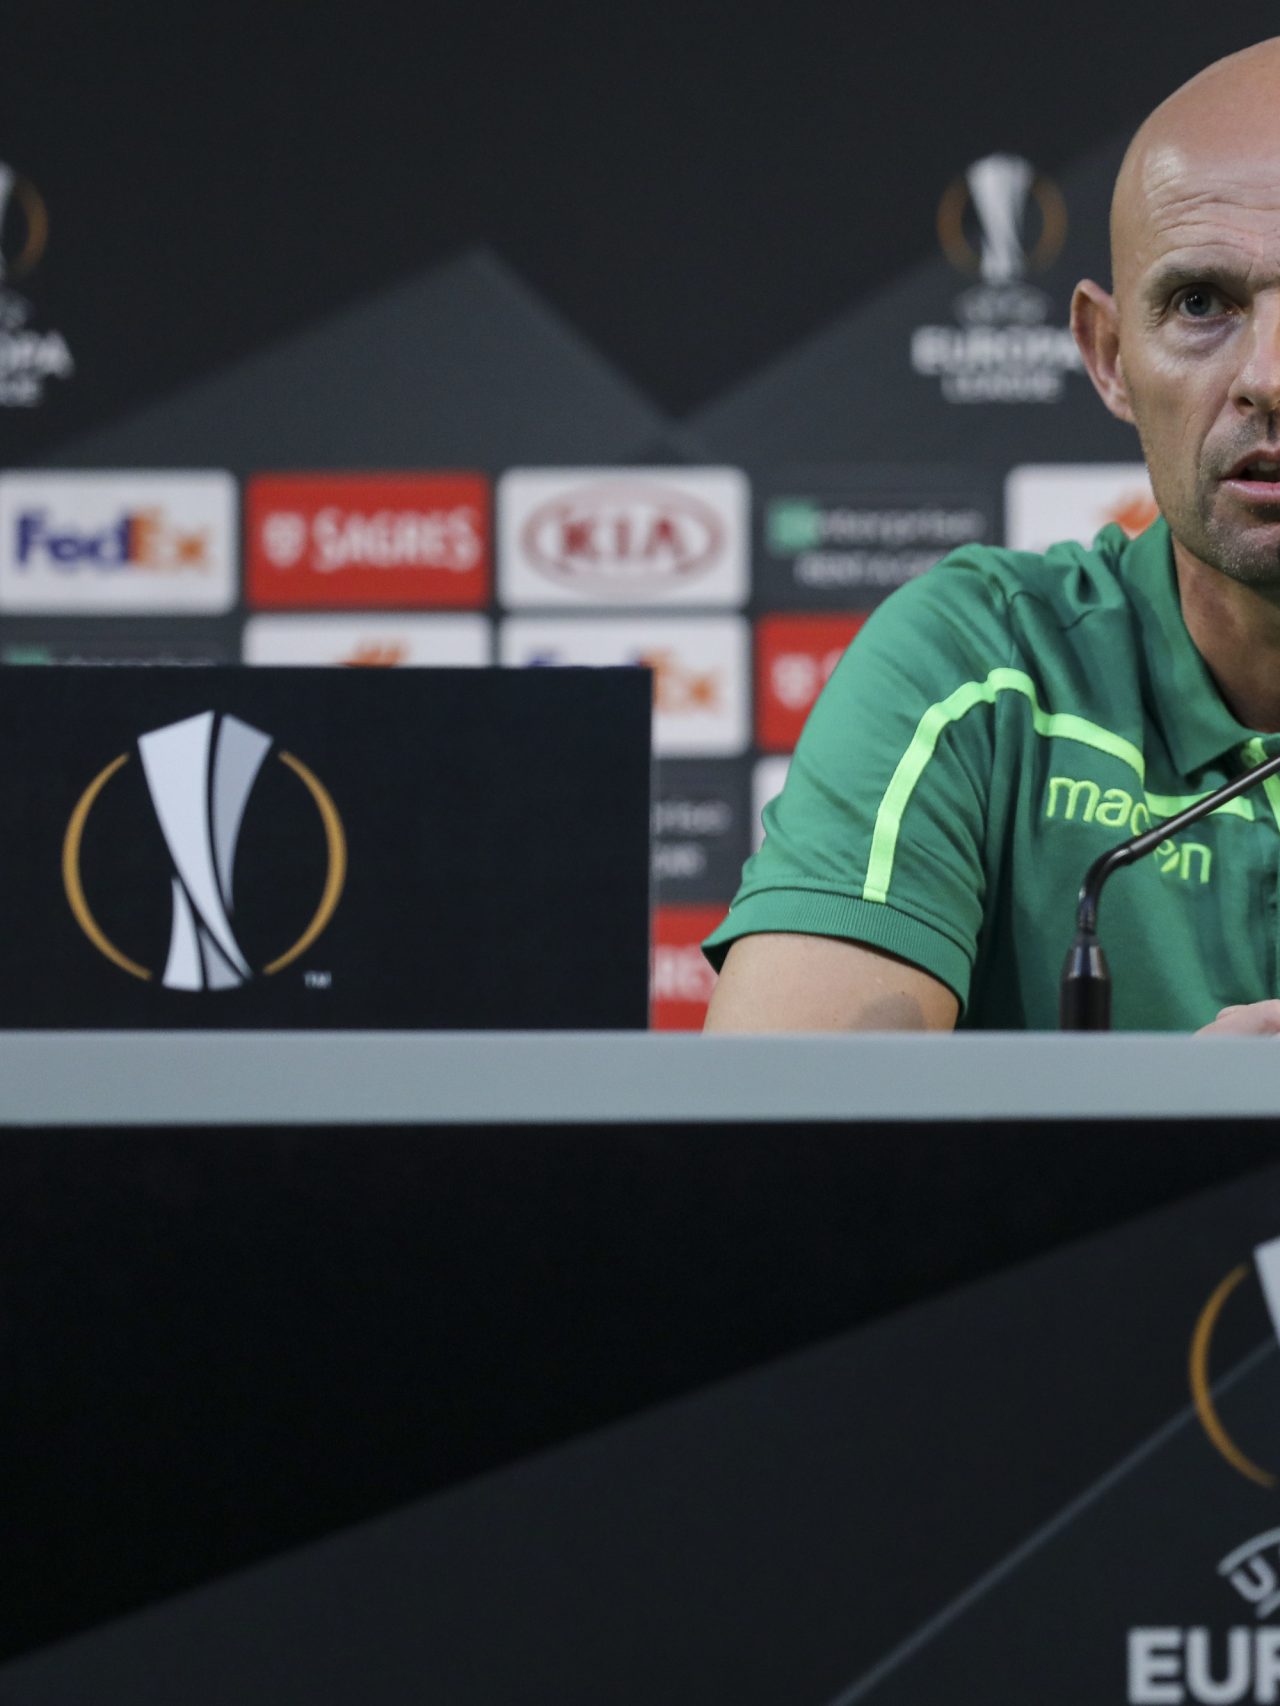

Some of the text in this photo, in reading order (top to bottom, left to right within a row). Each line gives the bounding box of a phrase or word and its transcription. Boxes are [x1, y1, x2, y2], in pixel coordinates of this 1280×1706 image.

[15, 505, 210, 574] FedEx
[313, 506, 482, 573] SAGRES
[557, 509, 697, 562] KIA
[1046, 776, 1212, 884] macon
